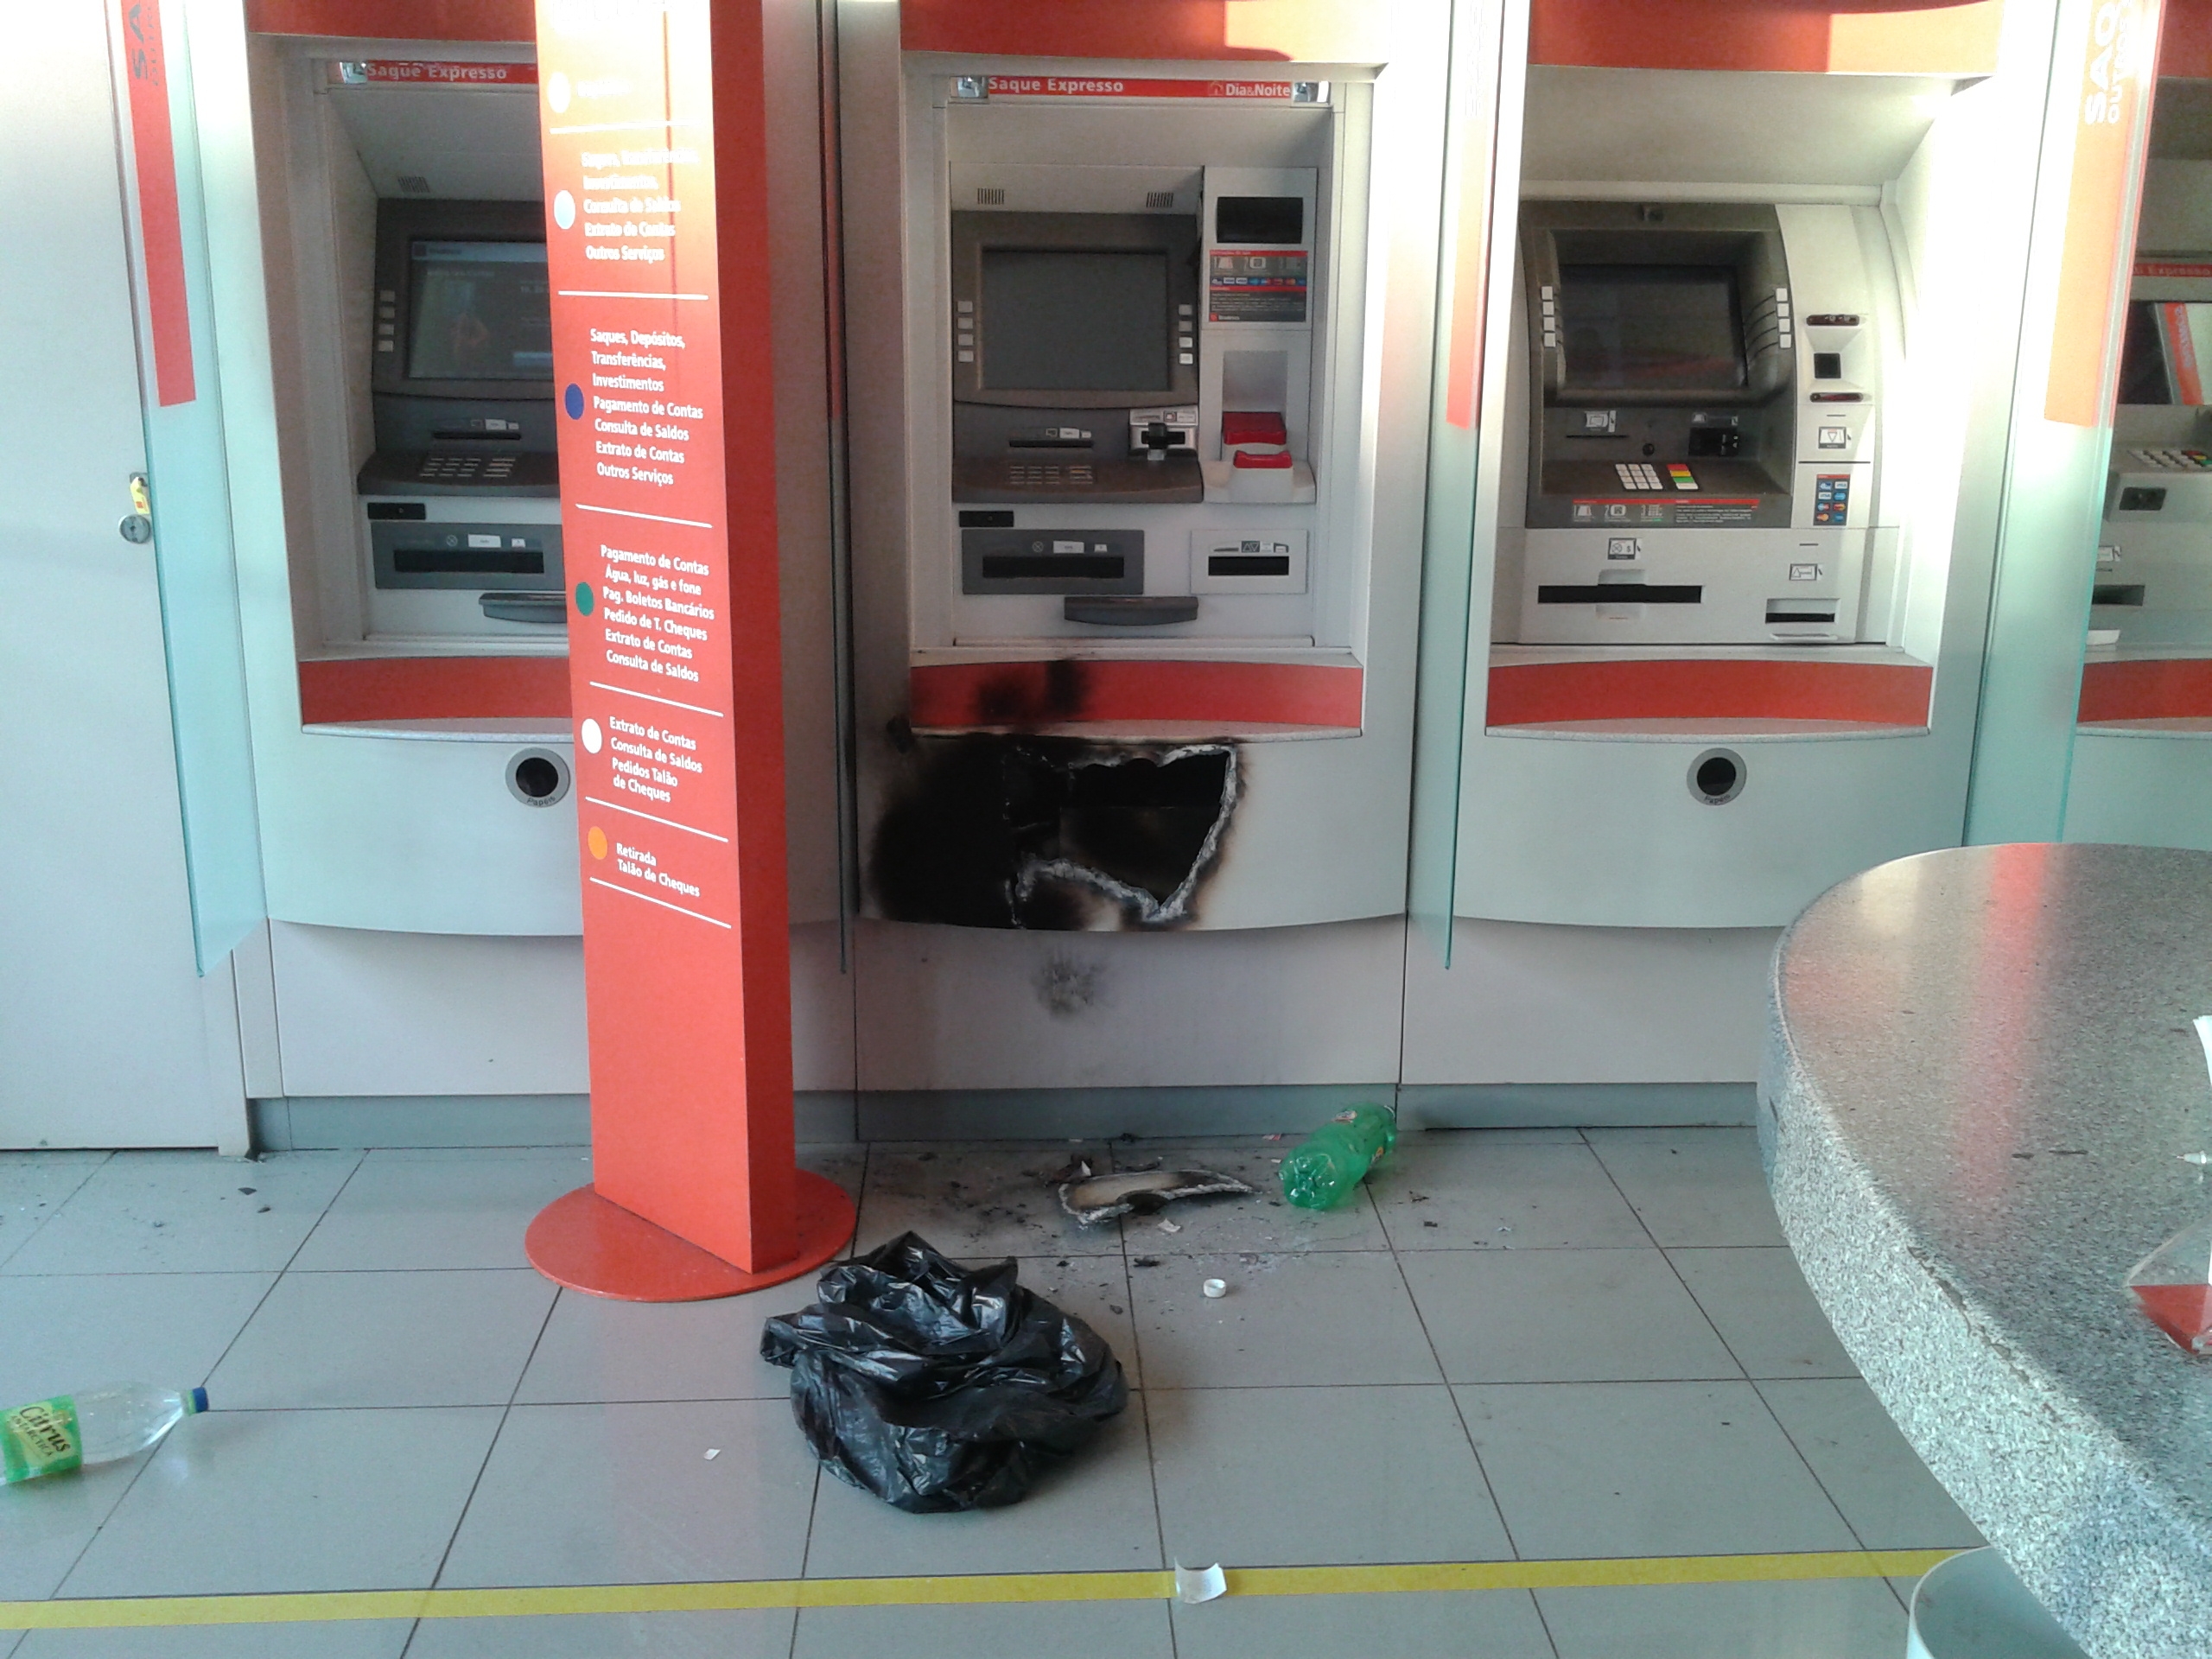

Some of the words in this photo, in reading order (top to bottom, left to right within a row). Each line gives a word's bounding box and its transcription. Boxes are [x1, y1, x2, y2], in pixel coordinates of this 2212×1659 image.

[366, 63, 421, 79] Saque
[429, 64, 507, 81] Expresso
[988, 77, 1040, 92] Saque
[1047, 78, 1123, 93] Expresso
[1225, 83, 1291, 97] Dia&Noite
[583, 197, 629, 213] Consulta
[629, 196, 643, 213] de
[645, 195, 682, 213] Saldos
[584, 222, 622, 237] Extrato
[623, 221, 638, 237] de
[639, 221, 676, 237] Contas
[585, 245, 620, 260] Outros
[620, 245, 665, 264] Serviços
[590, 328, 628, 346] Saques,
[630, 330, 685, 349] Depósitos,
[591, 350, 666, 371] Transferências,
[592, 372, 664, 391] Investimentos
[593, 396, 649, 414] Pagamento
[652, 400, 664, 416] de
[667, 402, 703, 419] Contas
[594, 418, 638, 435] Consulta
[640, 422, 652, 436] de
[656, 424, 690, 441] Saldos
[595, 441, 632, 457] Extrato
[634, 444, 646, 459] de
[649, 446, 684, 463] Contas
[596, 462, 629, 479] Outros
[632, 466, 674, 486] Serviços
[601, 544, 656, 567] Pagamento
[658, 554, 671, 569] de
[673, 557, 709, 575] Contas
[605, 564, 632, 584] Água,
[633, 570, 650, 587] luz,
[652, 575, 669, 590] gás
[671, 581, 677, 590] e
[678, 579, 702, 595] fone
[602, 586, 624, 605] Pag.
[626, 590, 663, 610] Boletos
[664, 598, 715, 620] Bancários
[604, 607, 637, 626] Pedido
[639, 614, 652, 629] de
[653, 618, 661, 631] T.
[664, 620, 708, 641] Cheques
[605, 628, 640, 647] Extrato
[643, 636, 656, 651] de
[658, 639, 693, 658] Contas
[607, 650, 648, 671] Consulta
[651, 659, 664, 673] de
[665, 663, 699, 683] Saldos
[609, 716, 645, 737] Extrato
[647, 725, 659, 741] de
[662, 730, 696, 751] Contas
[610, 737, 652, 759] Consulta
[654, 748, 667, 764] de
[669, 753, 702, 773] Saldos
[612, 757, 651, 779] Pedidos
[652, 767, 678, 787] Talão
[613, 774, 626, 790] de
[628, 779, 671, 803] Cheques
[616, 842, 657, 867] Retirada
[617, 859, 642, 878] Talão
[644, 868, 657, 882] de
[658, 874, 700, 897] Cheques
[19, 1406, 71, 1452] Citrus
